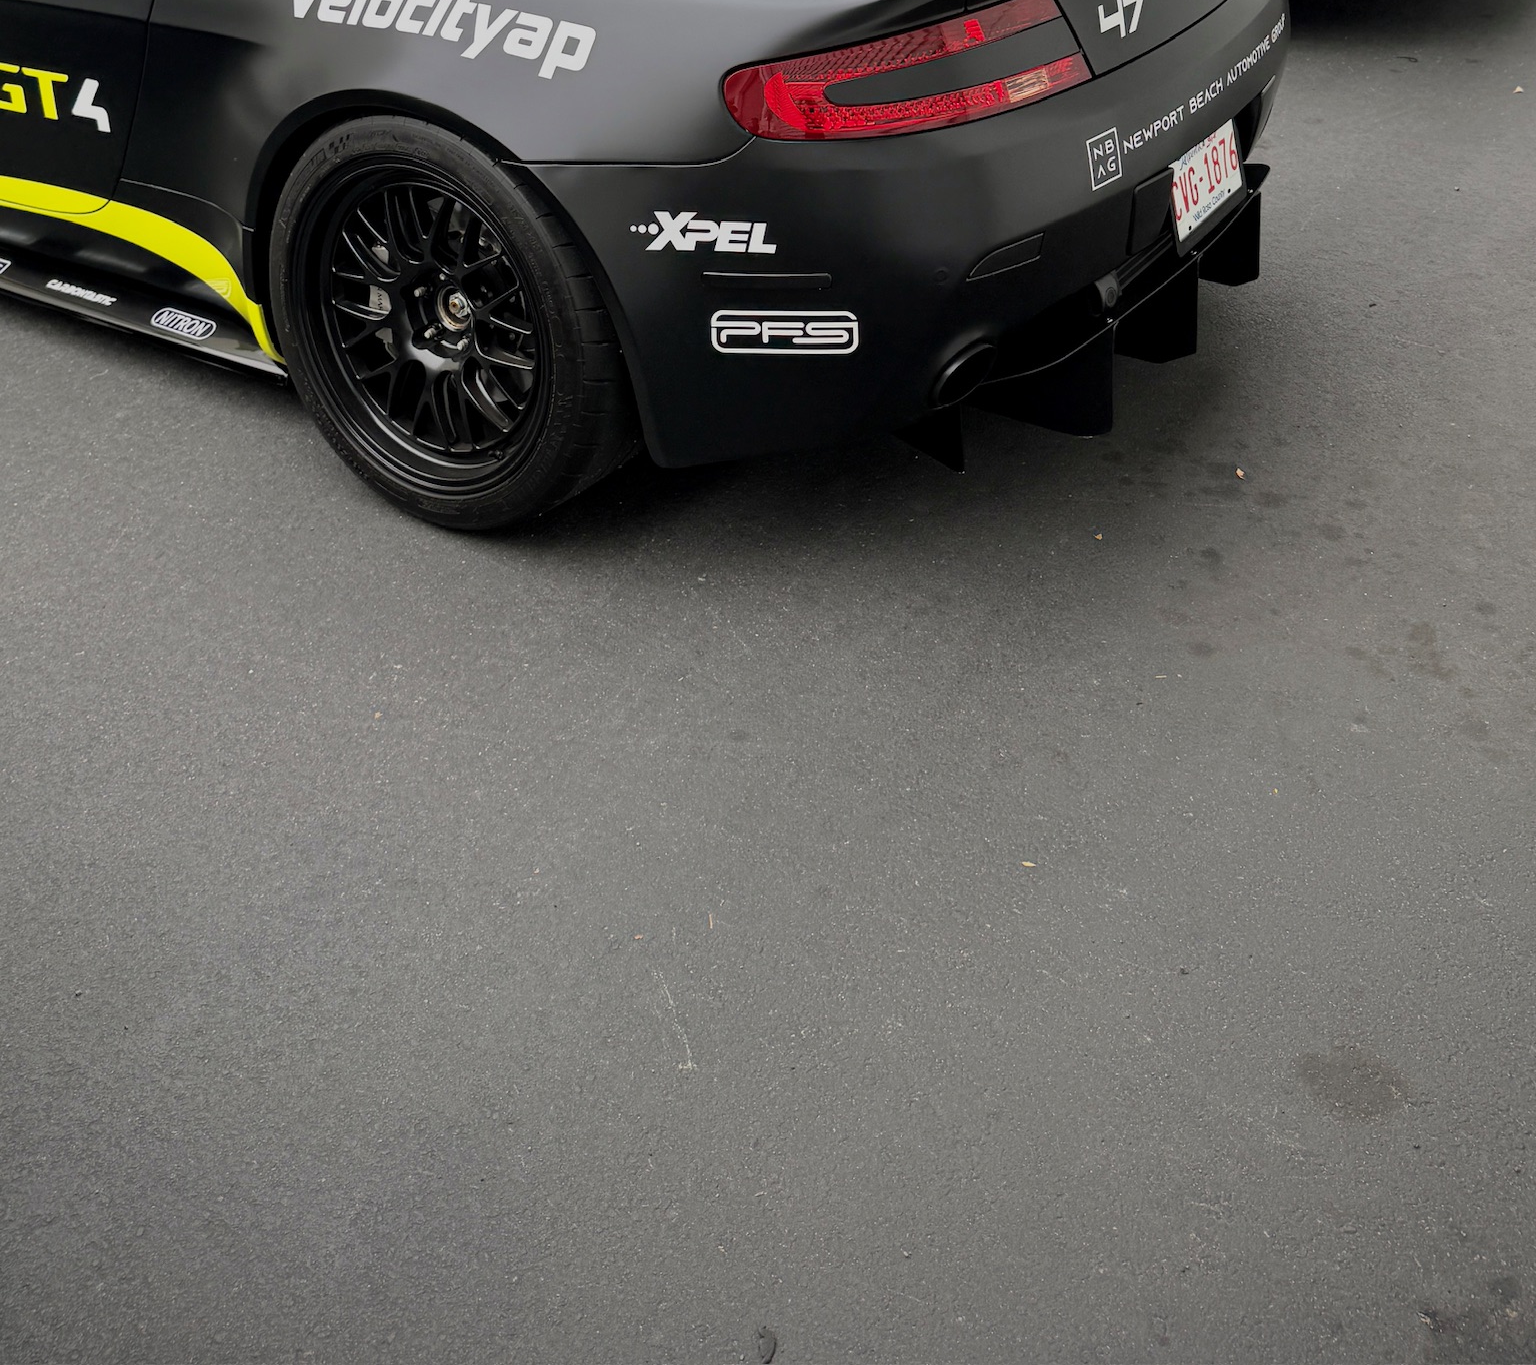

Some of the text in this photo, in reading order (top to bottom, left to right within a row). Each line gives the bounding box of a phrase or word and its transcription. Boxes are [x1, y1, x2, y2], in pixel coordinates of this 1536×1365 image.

[1122, 13, 1286, 155] NEWPORT BEACH AUTOMOTIVE GROUP
[1171, 131, 1239, 222] CVG-1876
[645, 211, 778, 255] XPEL
[156, 309, 212, 337] NITRON
[711, 320, 859, 346] PFS
